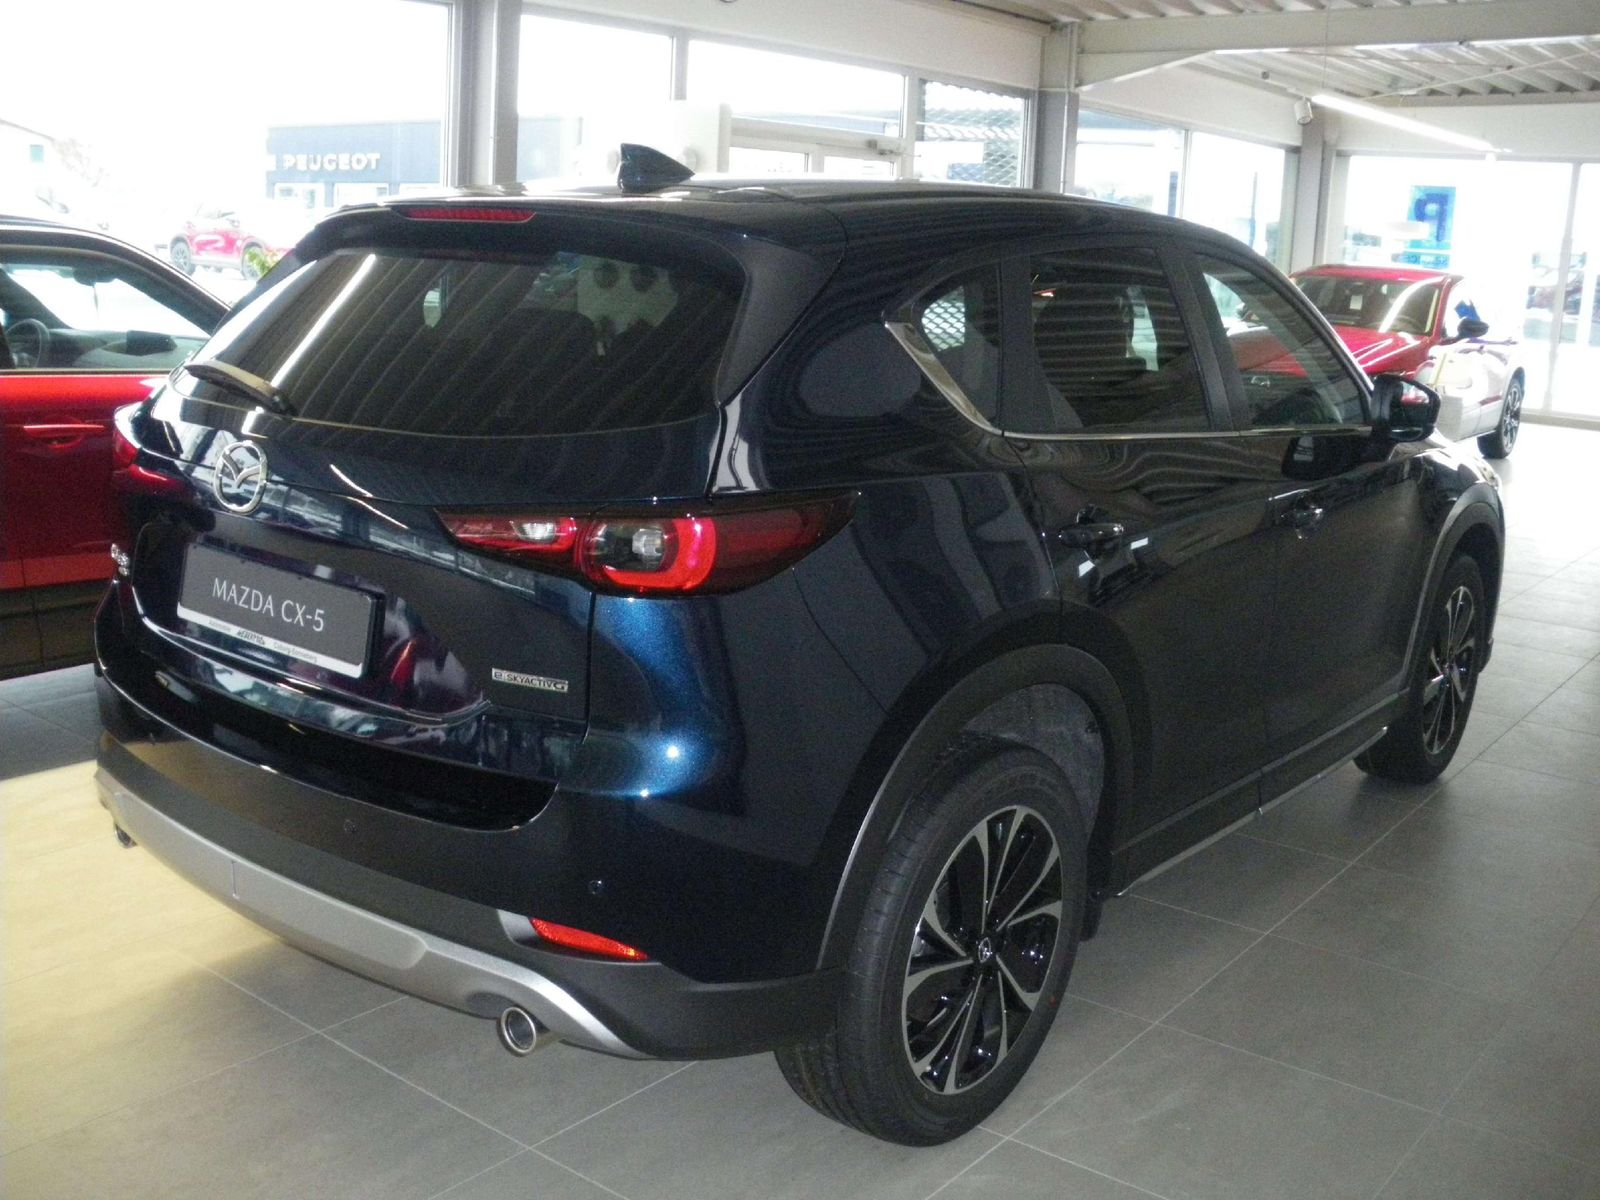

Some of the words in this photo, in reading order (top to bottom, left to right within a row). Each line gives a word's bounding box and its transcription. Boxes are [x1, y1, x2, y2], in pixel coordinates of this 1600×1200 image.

[283, 153, 380, 171] PEUGEOT
[212, 577, 275, 617] MAZDA
[281, 599, 325, 632] CX-5
